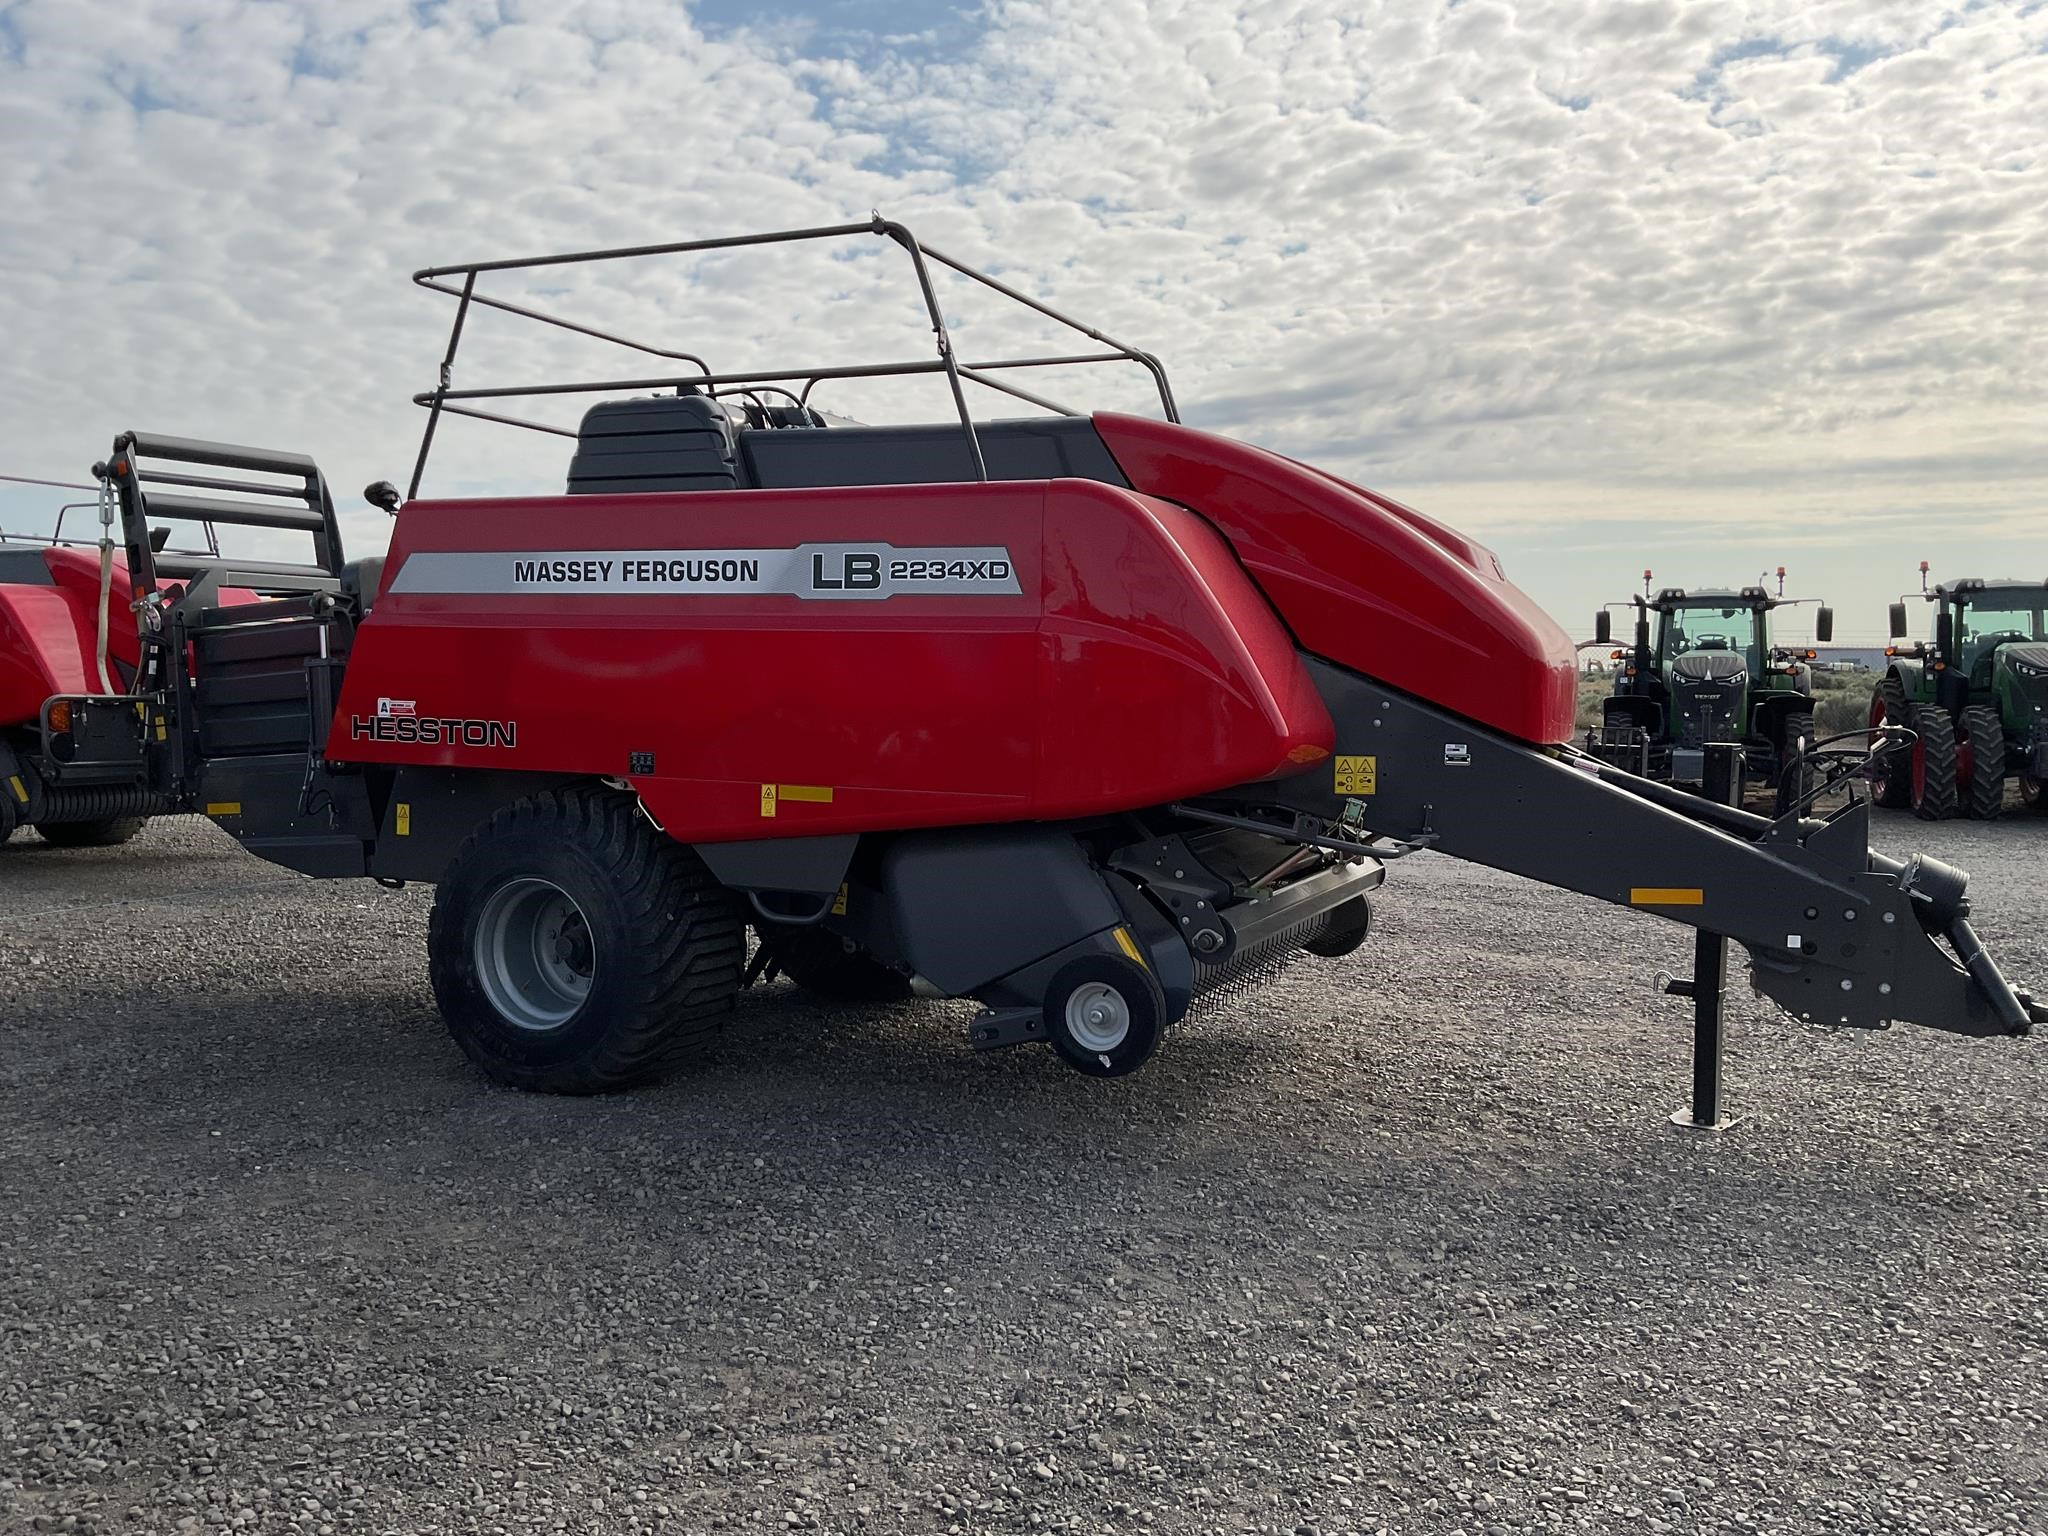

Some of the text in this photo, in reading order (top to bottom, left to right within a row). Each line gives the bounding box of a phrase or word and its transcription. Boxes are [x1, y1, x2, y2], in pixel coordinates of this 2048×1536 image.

[514, 559, 759, 582] MASSEY FERGUSON
[812, 553, 1010, 590] LB 2234XD
[351, 714, 517, 748] HESSTON
